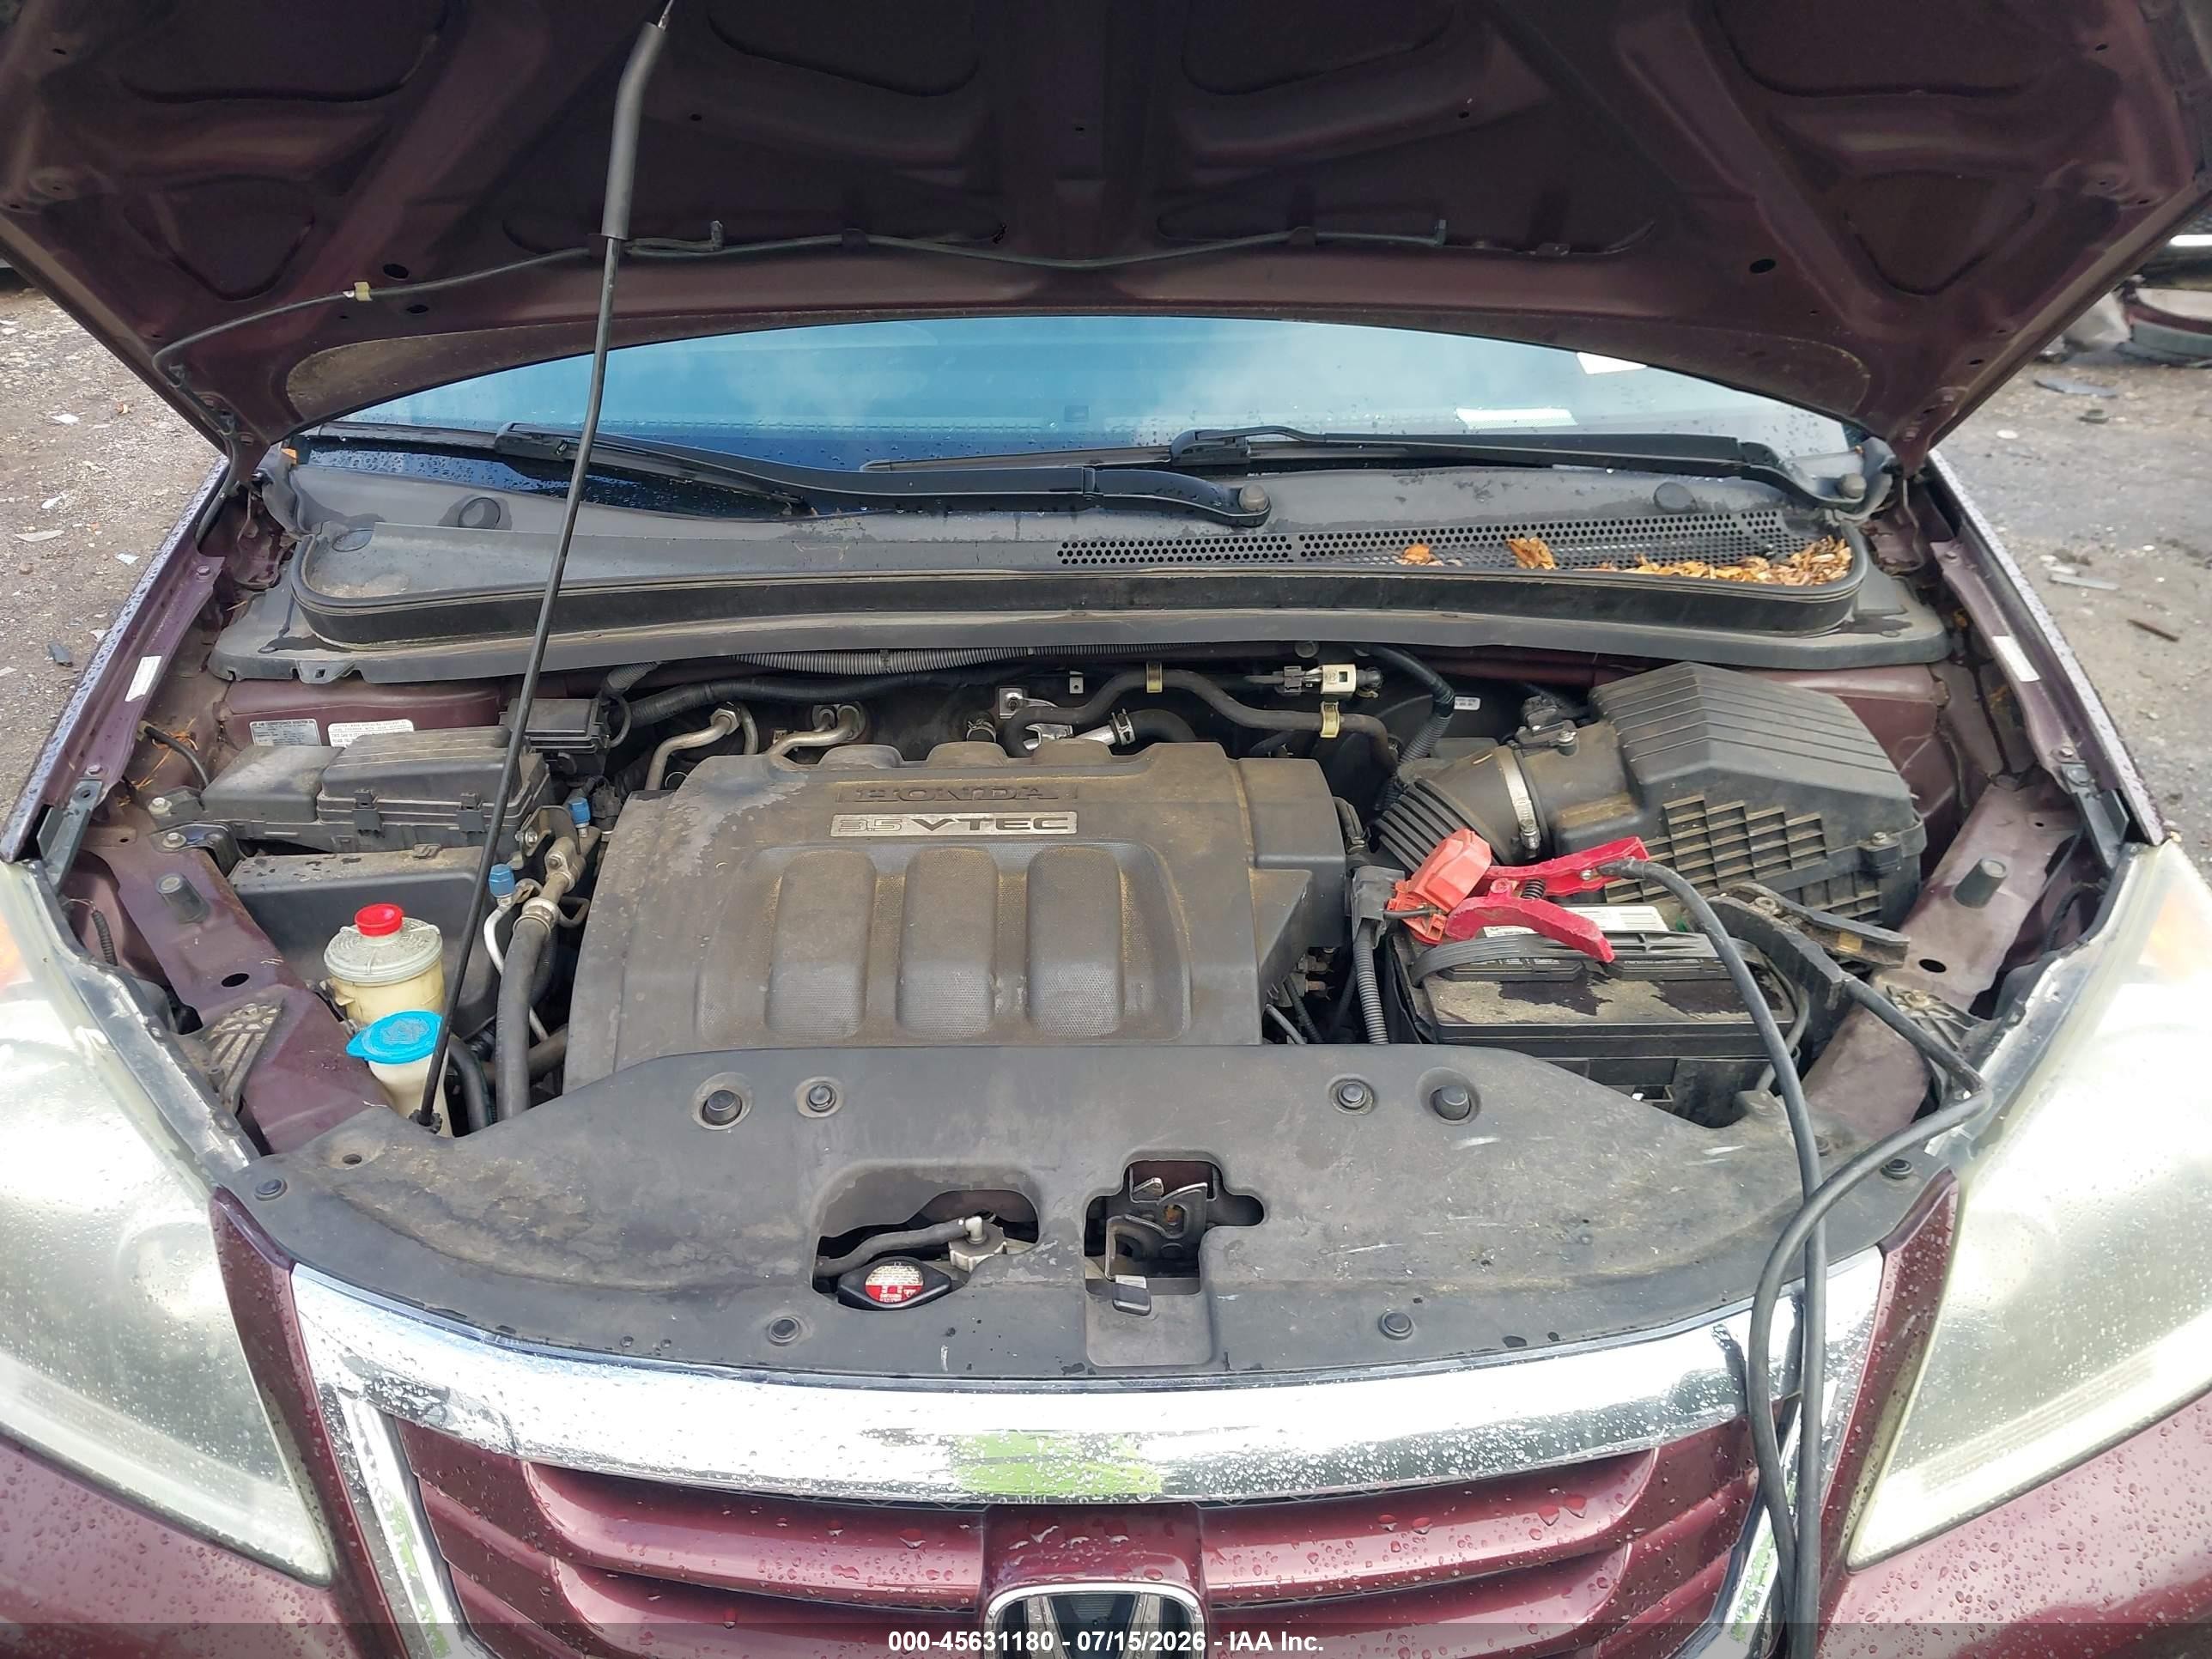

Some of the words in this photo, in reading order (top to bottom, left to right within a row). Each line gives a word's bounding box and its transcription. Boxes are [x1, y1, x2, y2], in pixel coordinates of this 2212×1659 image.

[854, 786, 1059, 802] HONDA
[838, 818, 902, 832] 3.5
[911, 817, 1068, 831] VTEC
